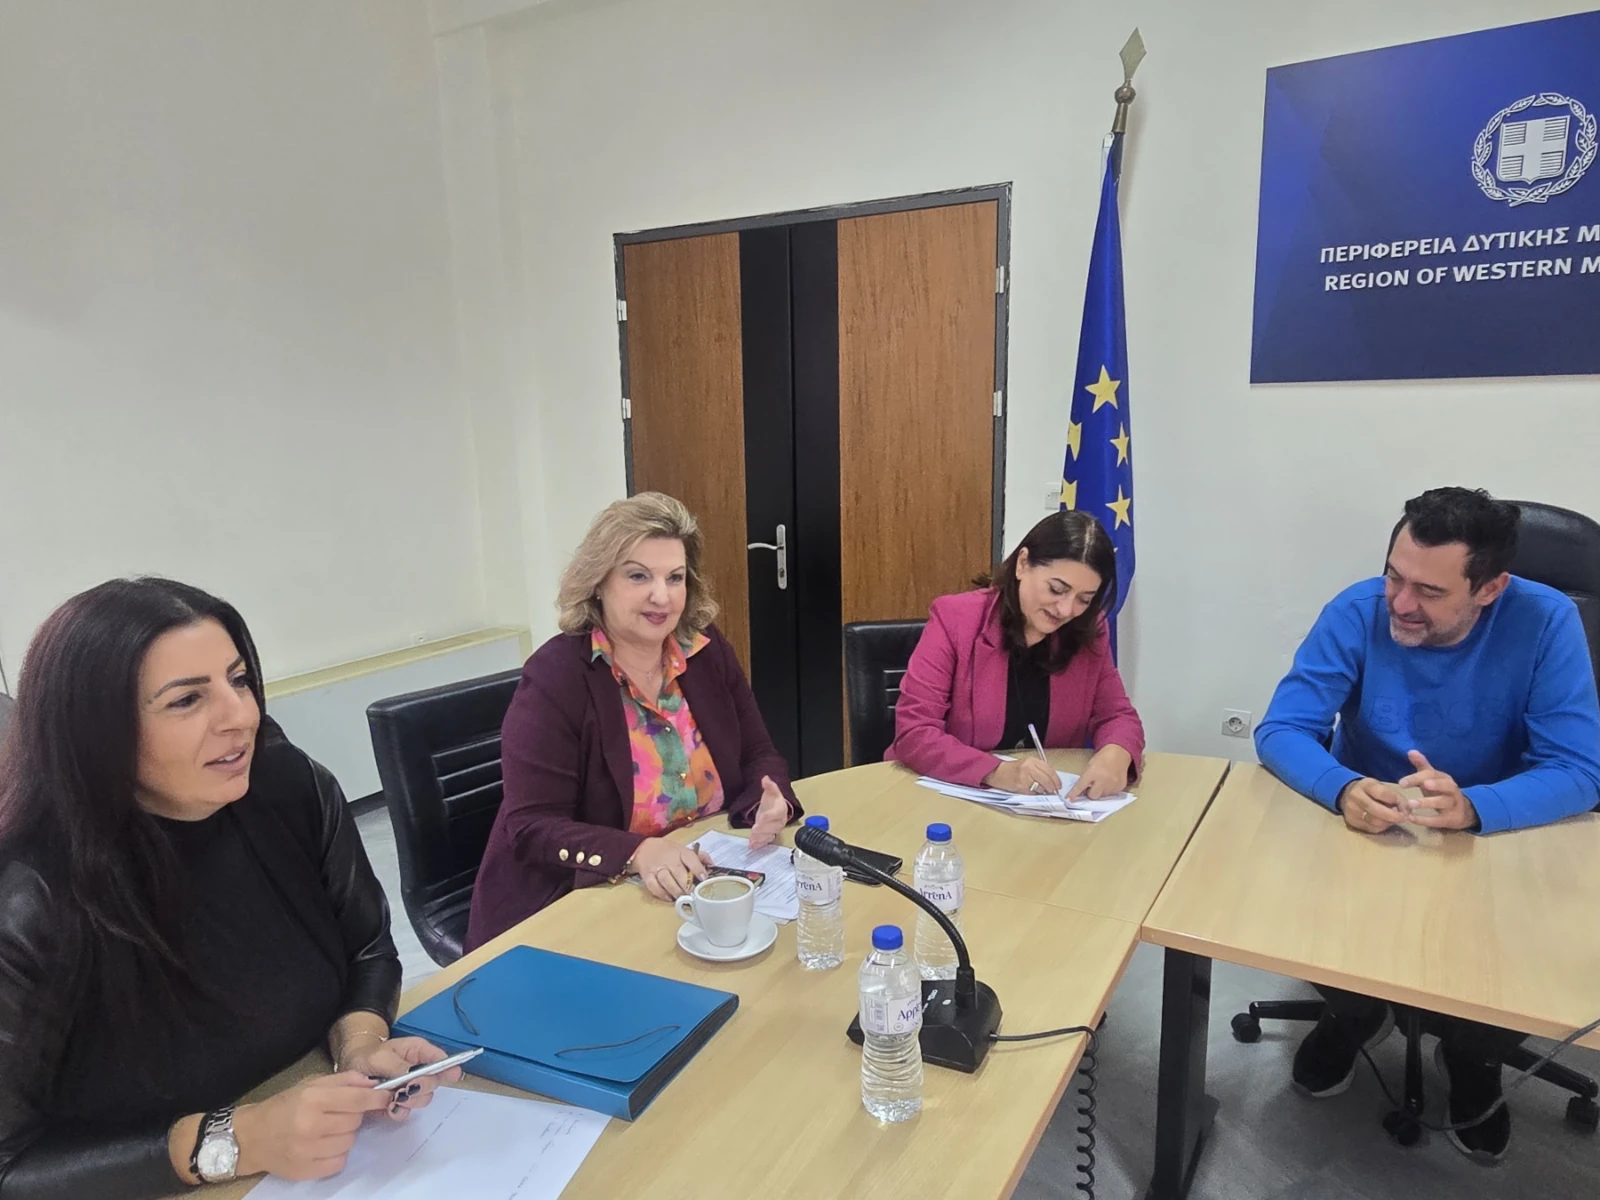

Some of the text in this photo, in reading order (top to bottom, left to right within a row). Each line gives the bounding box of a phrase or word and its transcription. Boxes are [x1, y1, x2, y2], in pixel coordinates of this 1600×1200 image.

[1320, 237, 1456, 264] ΠΕΡΙΦΕΡΕΙΑ
[1462, 226, 1570, 252] ΔΥΤΙΚΗΣ
[1325, 269, 1409, 291] REGION
[1417, 266, 1448, 285] OF
[1452, 257, 1572, 283] WESTERN
